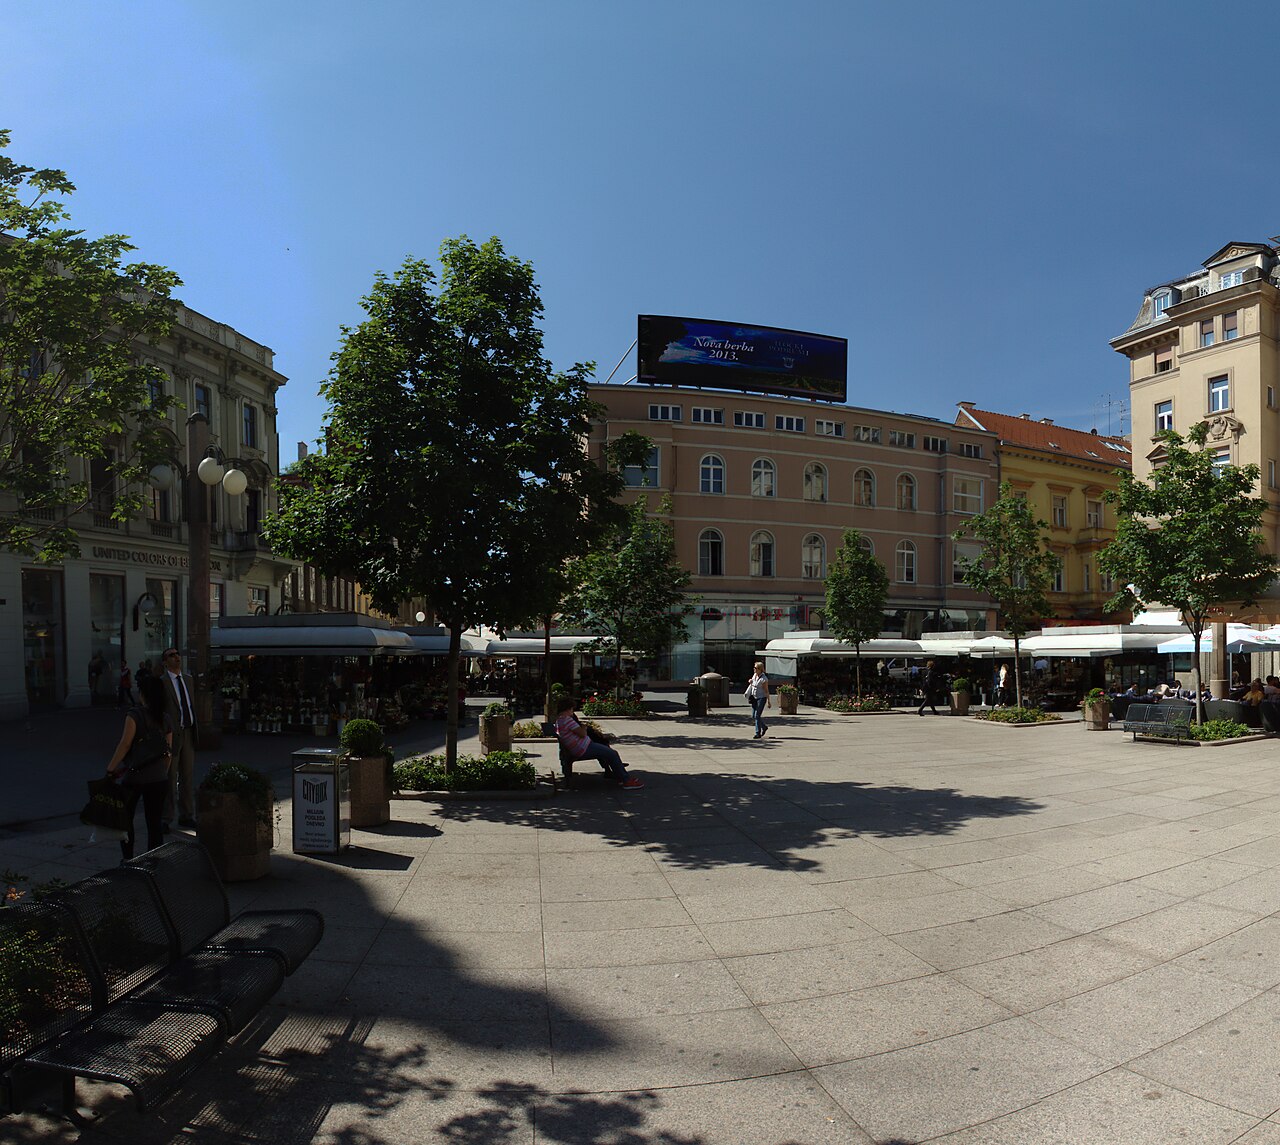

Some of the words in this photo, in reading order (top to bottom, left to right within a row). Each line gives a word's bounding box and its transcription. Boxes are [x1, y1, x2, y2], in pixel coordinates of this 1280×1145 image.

[694, 337, 722, 349] Nova
[724, 340, 755, 353] berba
[708, 350, 739, 361] 2013.
[92, 546, 131, 561] UNITED
[132, 550, 167, 566] COLORS
[302, 779, 328, 804] CITYBOX
